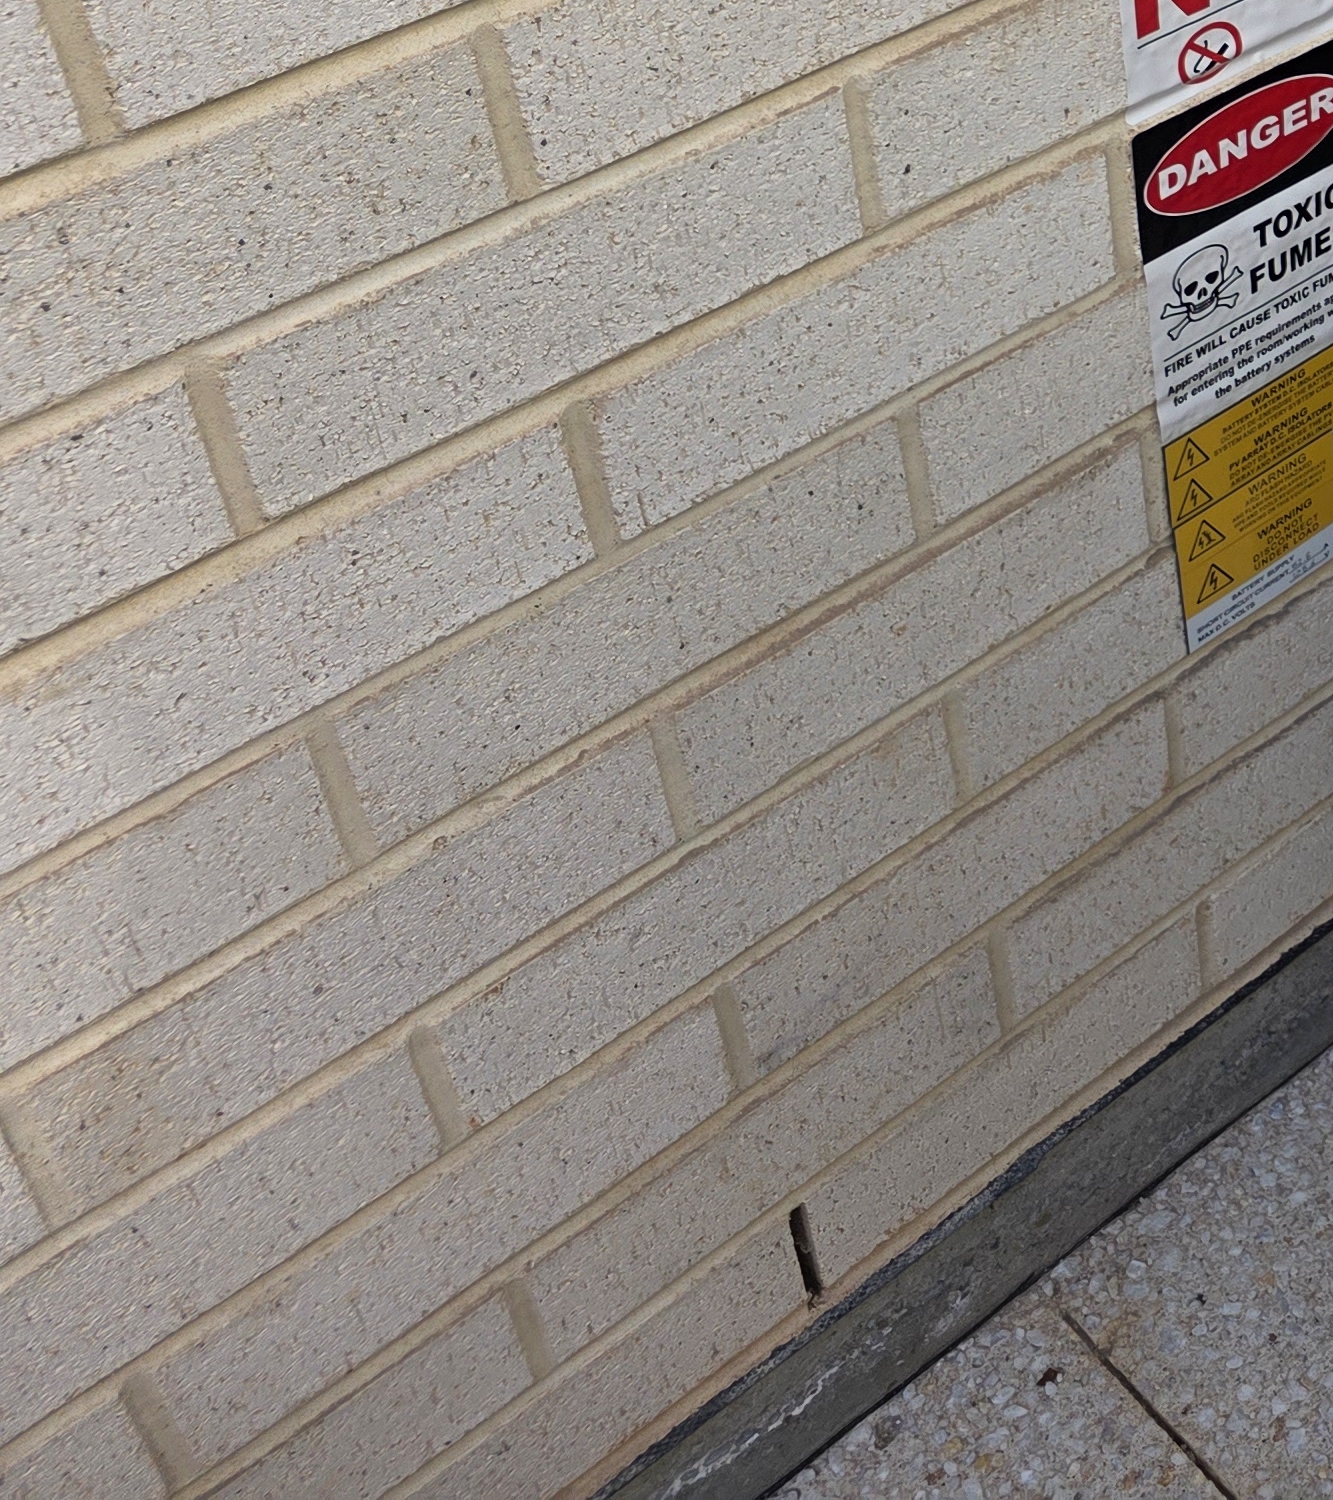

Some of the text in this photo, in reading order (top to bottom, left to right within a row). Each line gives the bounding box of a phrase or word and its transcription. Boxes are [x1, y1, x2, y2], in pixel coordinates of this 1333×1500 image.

[1164, 352, 1193, 378] FIRE
[1196, 332, 1226, 360] WILL
[1229, 307, 1270, 341] CAUSE
[1274, 285, 1309, 315] TOXIC
[1167, 352, 1229, 401] Appropriate
[1231, 339, 1251, 360] PPE
[1254, 299, 1320, 348] requirements
[1173, 389, 1189, 407] for
[1191, 363, 1234, 399] entering
[1236, 351, 1253, 371] the
[1256, 311, 1324, 362] room/working
[1214, 332, 1315, 400] the battery systems
[1251, 367, 1305, 408] WARNING
[1229, 458, 1239, 472] PV
[1241, 440, 1269, 464] ARRAY
[1287, 400, 1332, 435] ISOLATORS
[1253, 406, 1307, 446] WARNING
[1248, 451, 1306, 497] WARNING
[1252, 512, 1318, 563] DISCONNECT
[1257, 496, 1312, 540] WARNING
[1267, 513, 1303, 545] DO NOT
[1253, 541, 1289, 572] UNDER
[1293, 520, 1319, 545] LOAD
